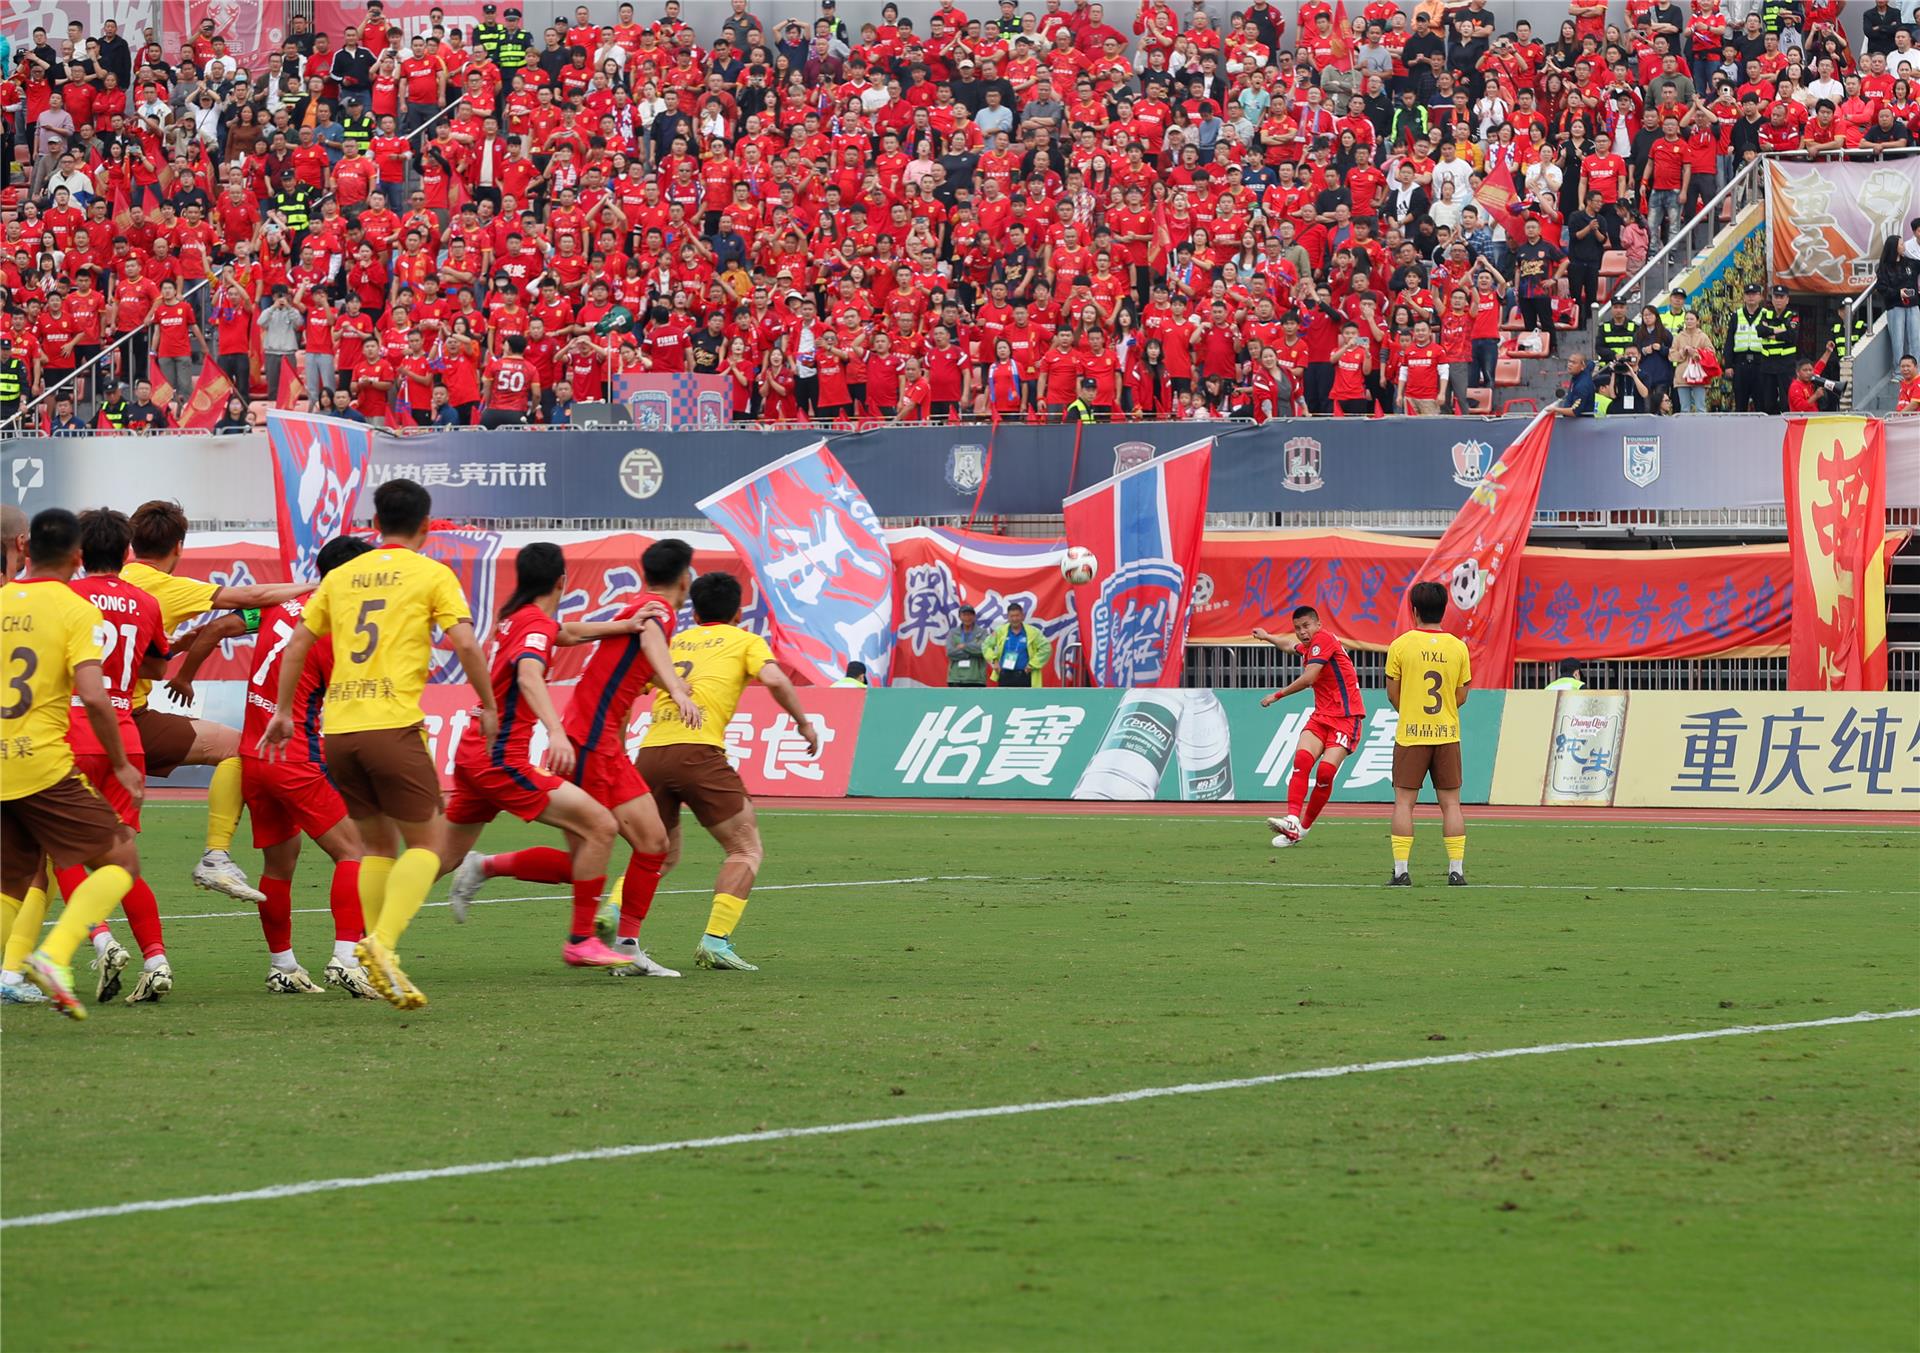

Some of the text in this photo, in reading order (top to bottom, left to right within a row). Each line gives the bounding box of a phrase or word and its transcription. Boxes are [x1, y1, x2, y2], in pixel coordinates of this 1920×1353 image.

[497, 369, 525, 392] 50
[352, 572, 371, 588] HU
[90, 594, 140, 616] SONG P.
[350, 598, 387, 665] 5
[253, 618, 294, 687] 7
[1420, 651, 1448, 664] YI X.L.
[1423, 669, 1443, 715] 3
[894, 704, 1086, 786] 怡寶
[1335, 731, 1349, 748] 14
